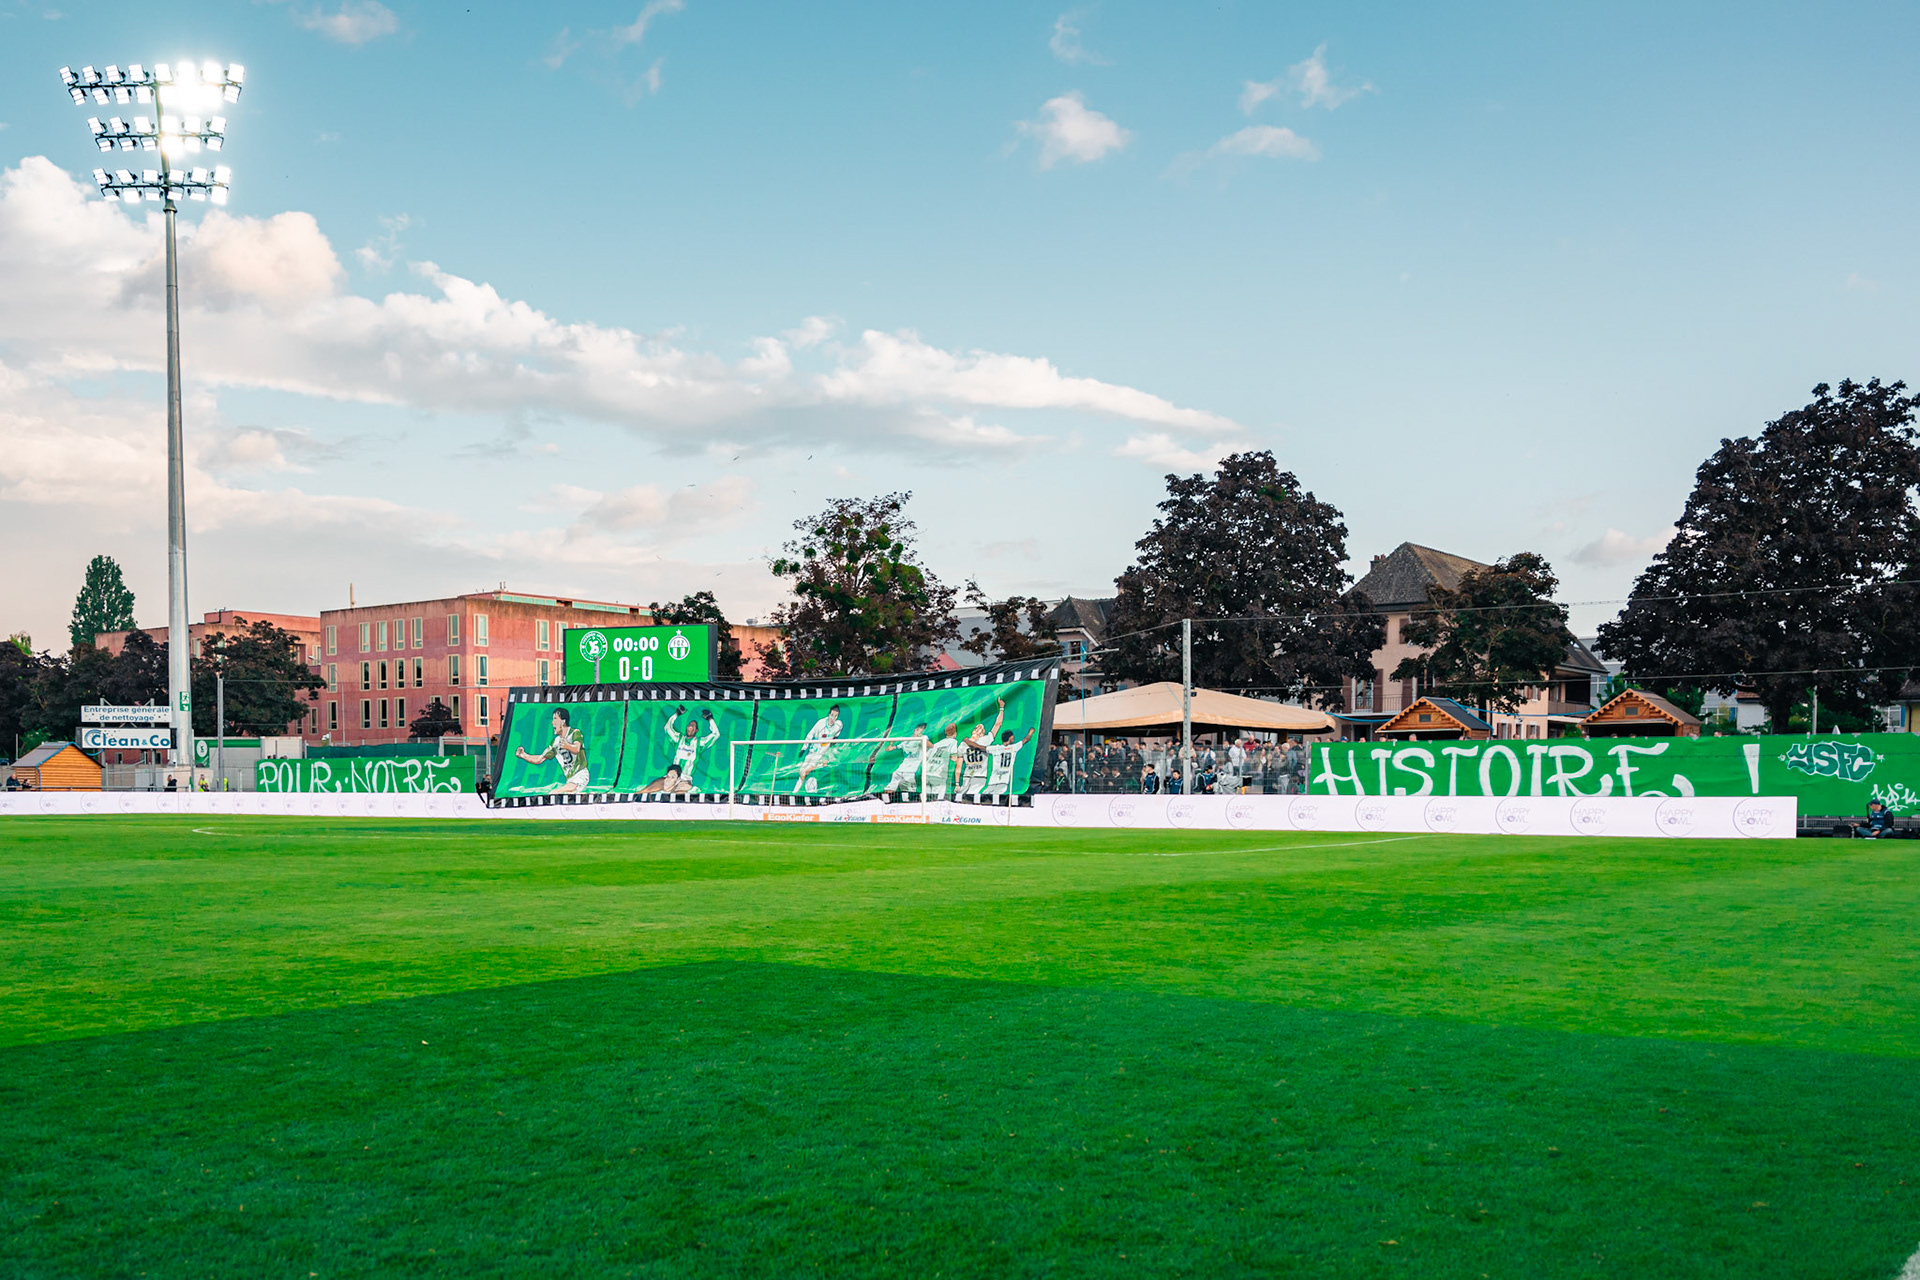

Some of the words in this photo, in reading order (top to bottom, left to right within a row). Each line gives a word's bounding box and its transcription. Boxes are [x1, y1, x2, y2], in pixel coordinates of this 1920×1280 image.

[613, 637, 659, 652] 00:00
[1000, 752, 1011, 767] 18
[1312, 742, 1695, 797] HISTOIRE
[1786, 741, 1876, 782] YSFC
[259, 761, 342, 793] POUR
[351, 759, 462, 793] NOTRE
[877, 814, 925, 823] EgoKiefe
